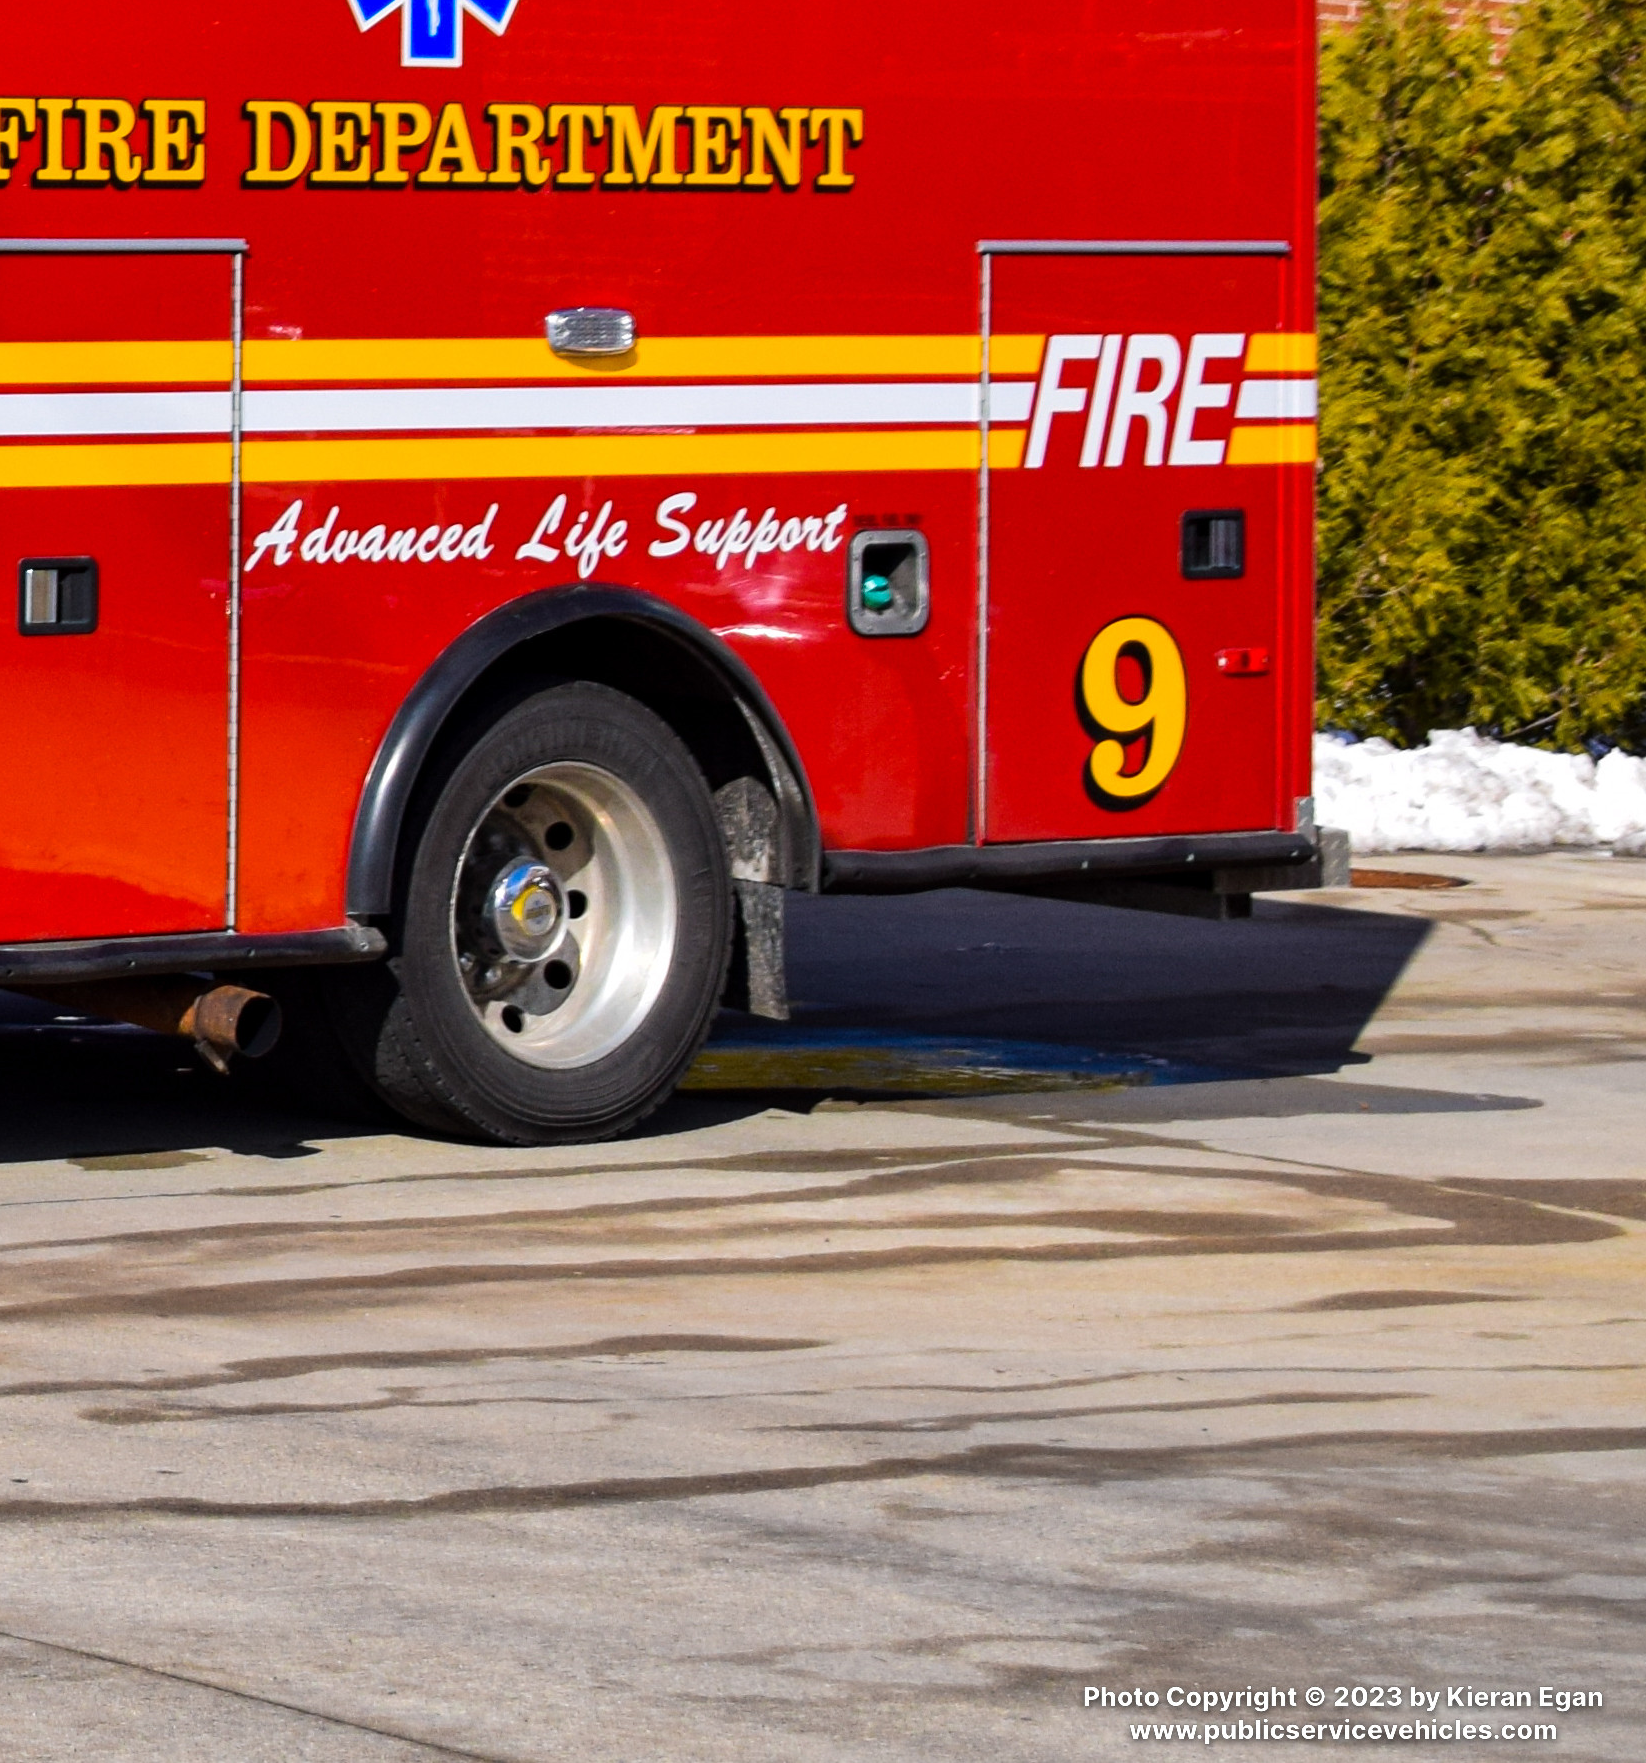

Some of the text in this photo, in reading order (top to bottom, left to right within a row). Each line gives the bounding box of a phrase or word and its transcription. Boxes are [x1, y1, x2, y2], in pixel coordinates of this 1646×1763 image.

[244, 99, 864, 189] DEPARTMENT
[1022, 333, 1246, 468] FIRE
[244, 491, 849, 580] Advanced Life Support
[1076, 616, 1188, 807] 9
